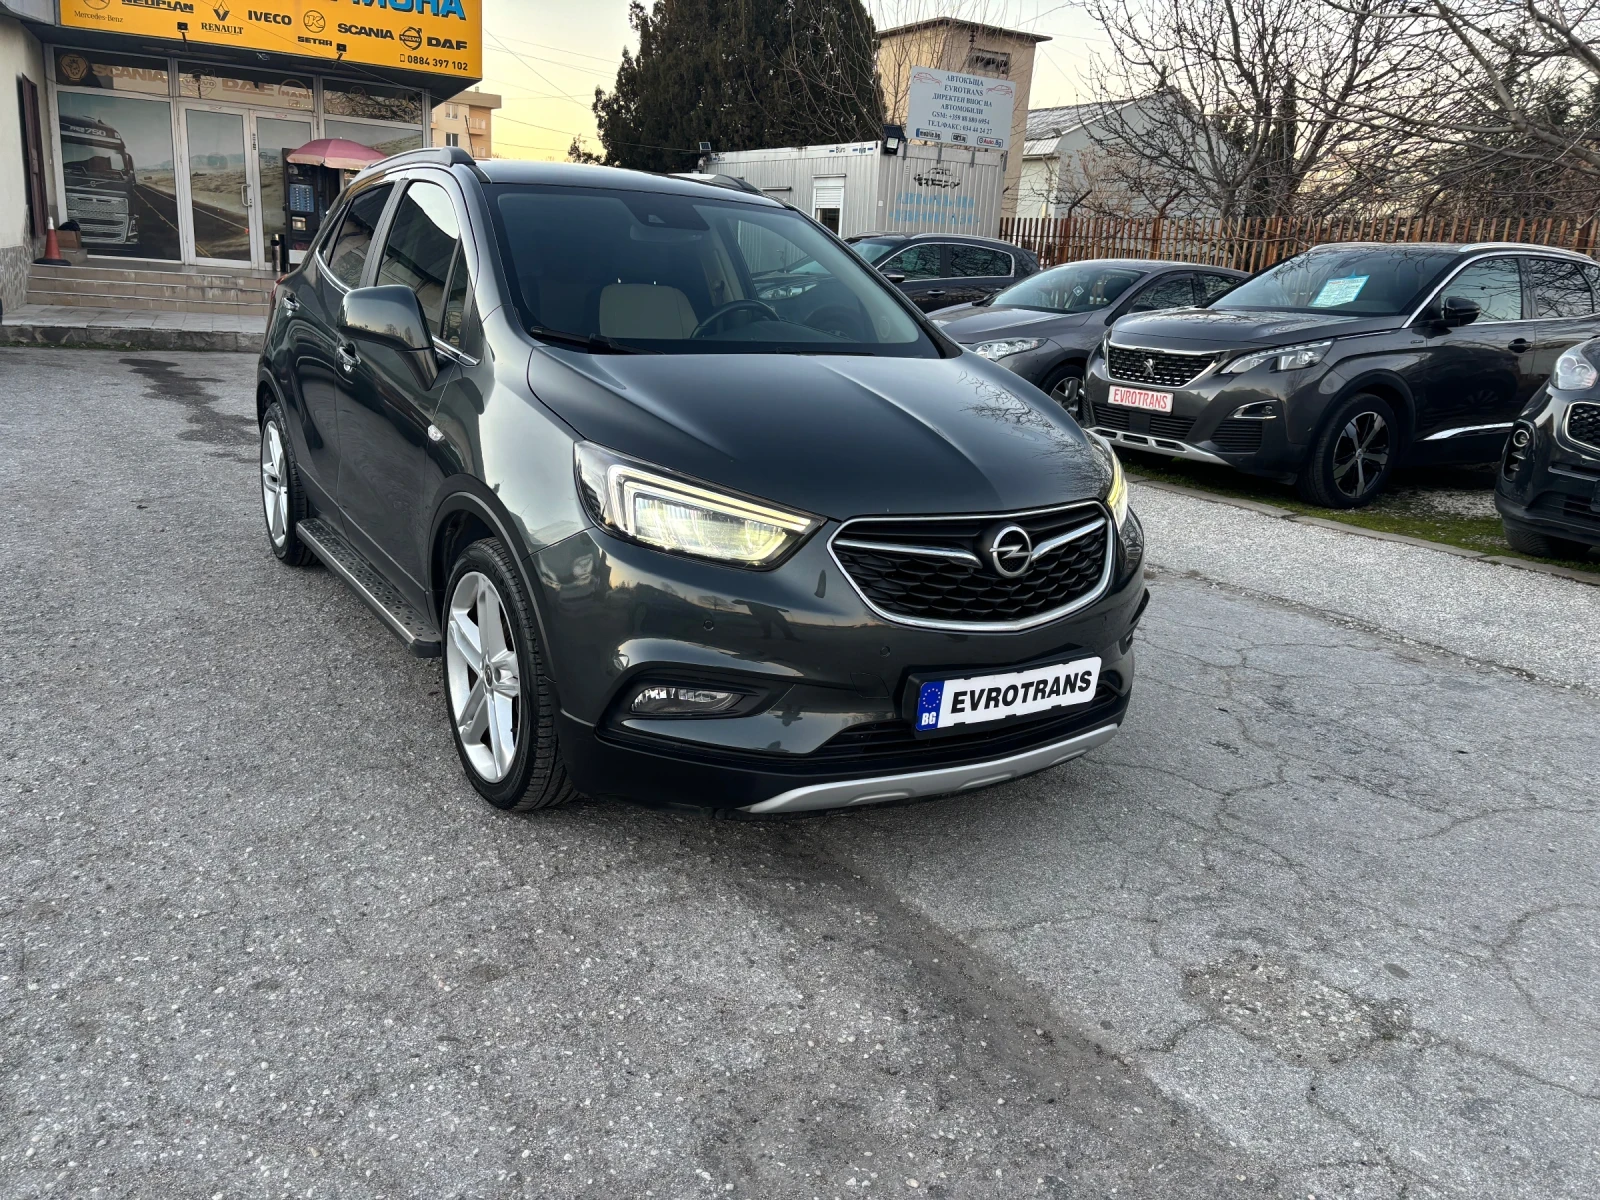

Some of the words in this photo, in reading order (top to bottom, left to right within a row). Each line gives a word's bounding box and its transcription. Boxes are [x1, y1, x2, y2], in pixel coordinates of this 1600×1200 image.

[74, 10, 124, 23] Mercedes-Benz
[248, 10, 292, 26] IVECO
[201, 22, 244, 35] RENAULT
[337, 23, 395, 40] SCANIA
[298, 36, 332, 46] SETRA
[427, 36, 468, 50] DAF
[407, 55, 430, 66] 0884
[432, 58, 449, 68] 397
[452, 61, 468, 71] 102
[90, 63, 167, 83] SCANIA
[221, 78, 274, 93] DAF
[946, 75, 984, 86] АВТОКЪЩА
[281, 90, 307, 99] MAN
[944, 85, 984, 96] EVROTRANS
[932, 93, 965, 103] ДИРЕКТЕН
[932, 111, 948, 119] GSM:
[941, 104, 983, 115] АВТОМОБИЛИ
[1113, 388, 1168, 410] EVROTRANS
[921, 711, 937, 726] BG
[950, 670, 1093, 714] EVROTRANS
